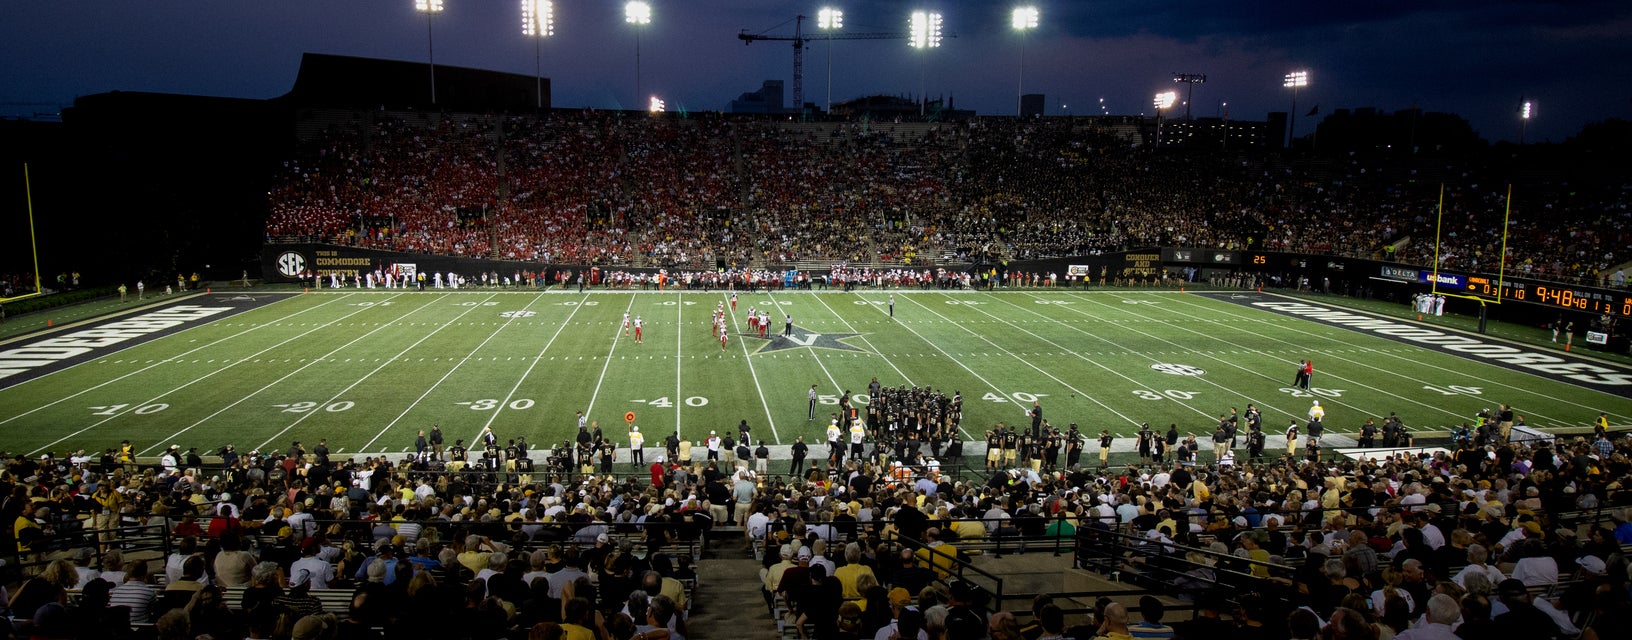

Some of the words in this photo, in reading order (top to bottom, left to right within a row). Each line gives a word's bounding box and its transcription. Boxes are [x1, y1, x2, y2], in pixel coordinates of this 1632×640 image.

[278, 253, 305, 275] SEC
[316, 257, 370, 266] COMMODORE
[1253, 255, 1266, 264] 25
[1392, 267, 1416, 278] DELTA
[1483, 284, 1490, 294] 0
[1492, 287, 1498, 296] 3
[1514, 289, 1525, 300] 10
[1537, 286, 1573, 307] 9:48
[1572, 298, 1587, 309] 48
[1604, 303, 1611, 313] 3
[1251, 301, 1632, 386] COMMODORES
[1132, 389, 1194, 400] 30
[1278, 387, 1342, 398] 20
[1423, 385, 1483, 395] 10
[648, 396, 709, 408] 40
[817, 394, 872, 405] 50
[981, 392, 1038, 402] 40
[92, 403, 170, 415] 10
[281, 401, 356, 413] 20
[469, 398, 536, 411] 30
